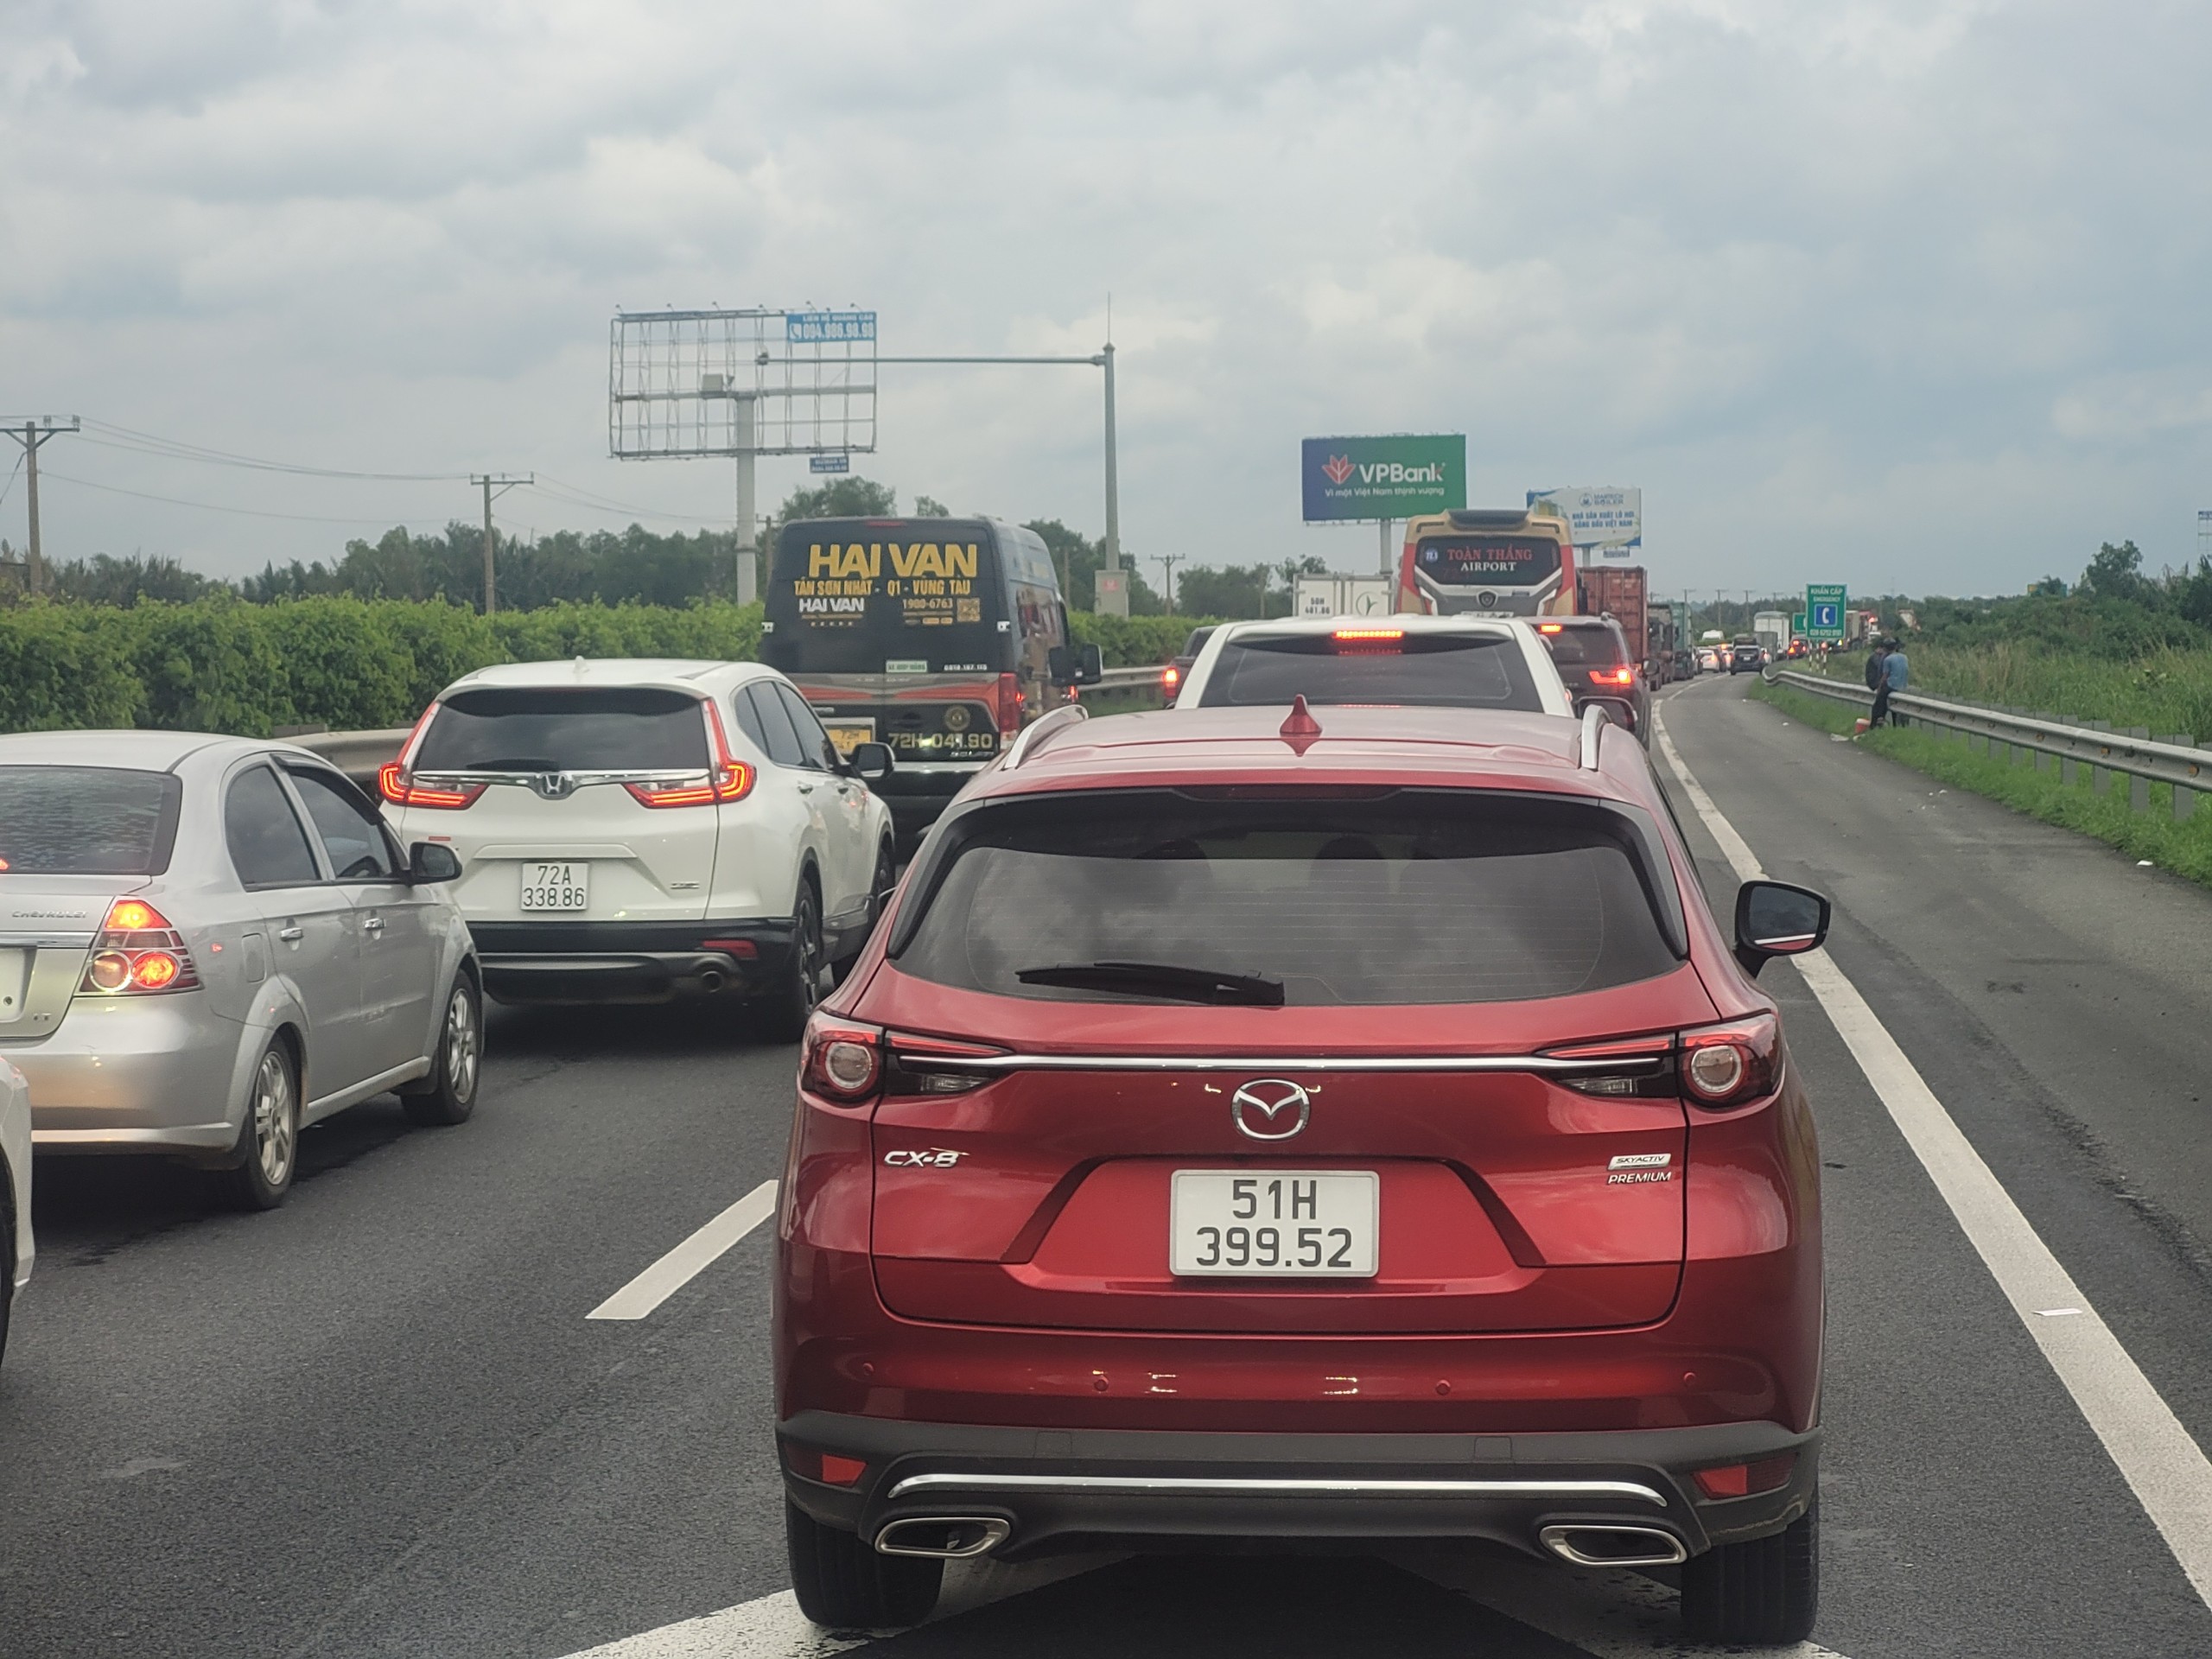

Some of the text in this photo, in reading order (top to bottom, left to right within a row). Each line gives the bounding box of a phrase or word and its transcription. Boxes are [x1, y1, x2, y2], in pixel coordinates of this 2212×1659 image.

[1359, 462, 1443, 483] VPBank
[1355, 487, 1370, 497] Việt
[1395, 486, 1416, 496] thịnh
[1418, 486, 1445, 496] vượng
[809, 543, 977, 579] HAI VAN
[1447, 545, 1482, 561] TOÀN
[1460, 562, 1516, 571] AIRPORT
[887, 580, 900, 596] Q1
[799, 597, 864, 613] HAI VAN
[537, 865, 571, 886] 72A
[523, 887, 586, 907] 338.86
[884, 1150, 959, 1167] CX-8
[1616, 1155, 1665, 1164] SKYACTIV
[1607, 1171, 1672, 1185] PREMIUM
[1233, 1179, 1317, 1220] 51H
[1197, 1227, 1352, 1267] 399.52
